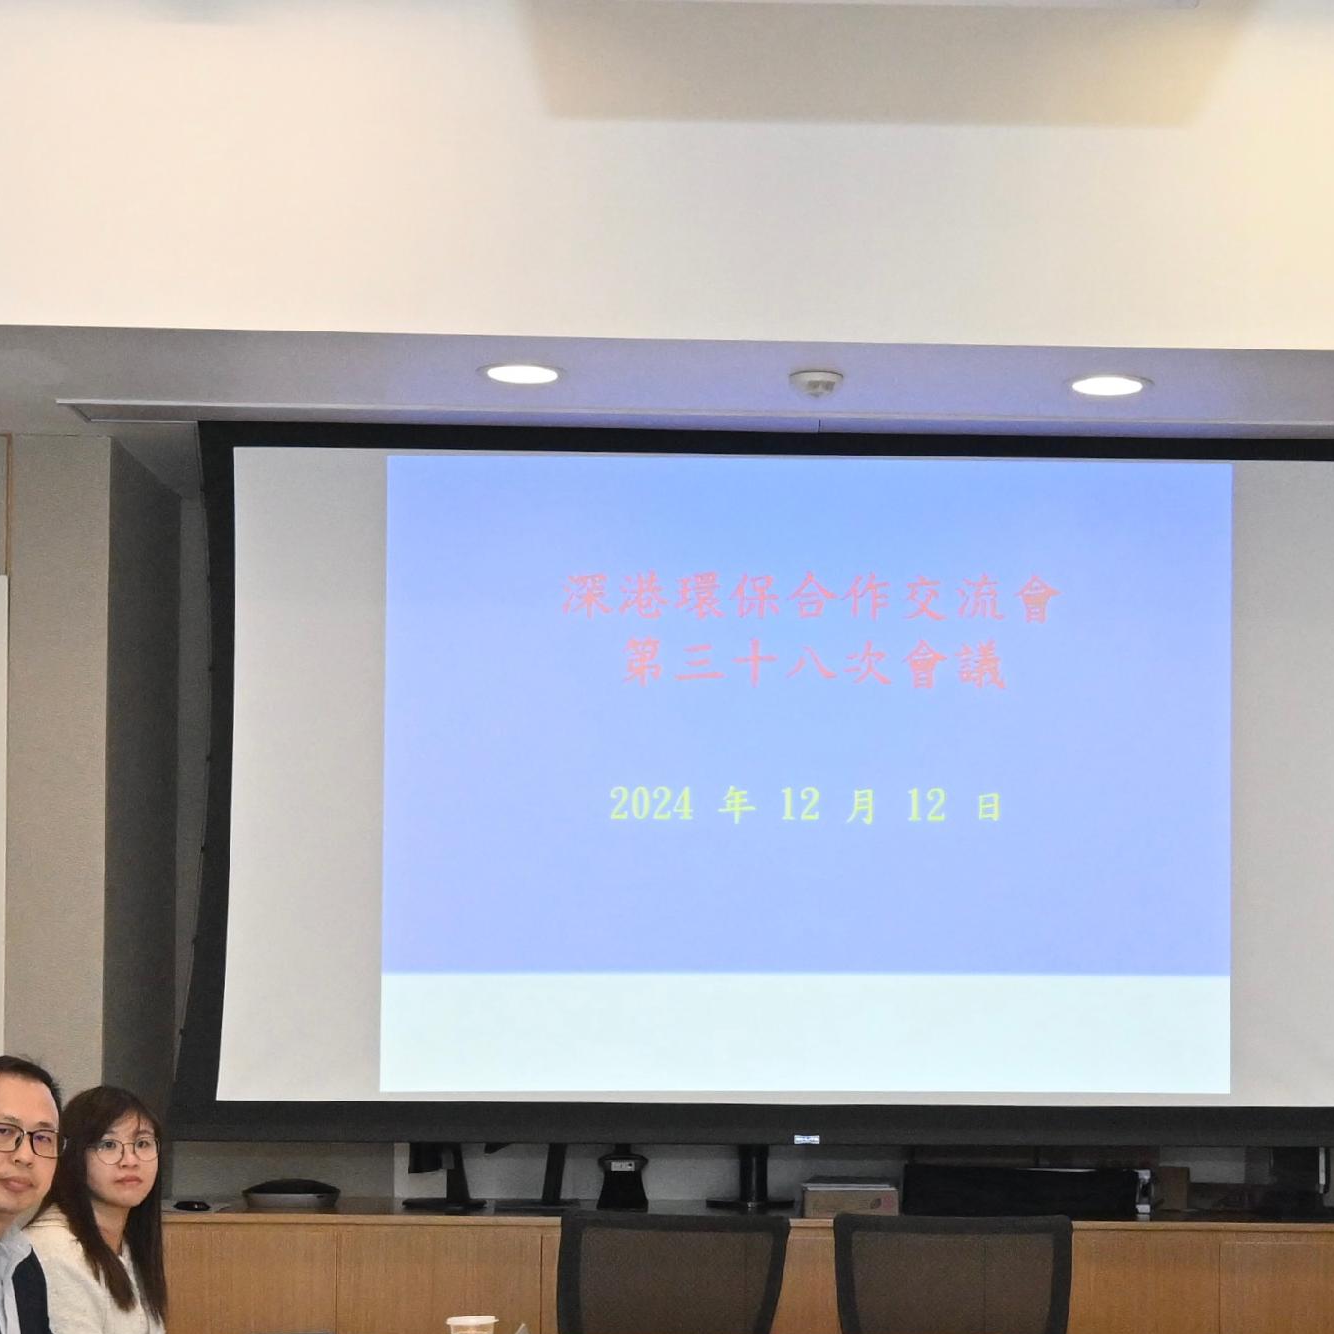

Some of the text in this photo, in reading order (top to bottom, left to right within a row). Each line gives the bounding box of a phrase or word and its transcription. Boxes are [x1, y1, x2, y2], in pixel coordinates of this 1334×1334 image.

[561, 569, 1064, 624] 深港環保合作交流會
[622, 634, 1007, 689] 第三十八次會議
[609, 784, 1002, 825] 2024 年 12 月 12 日
